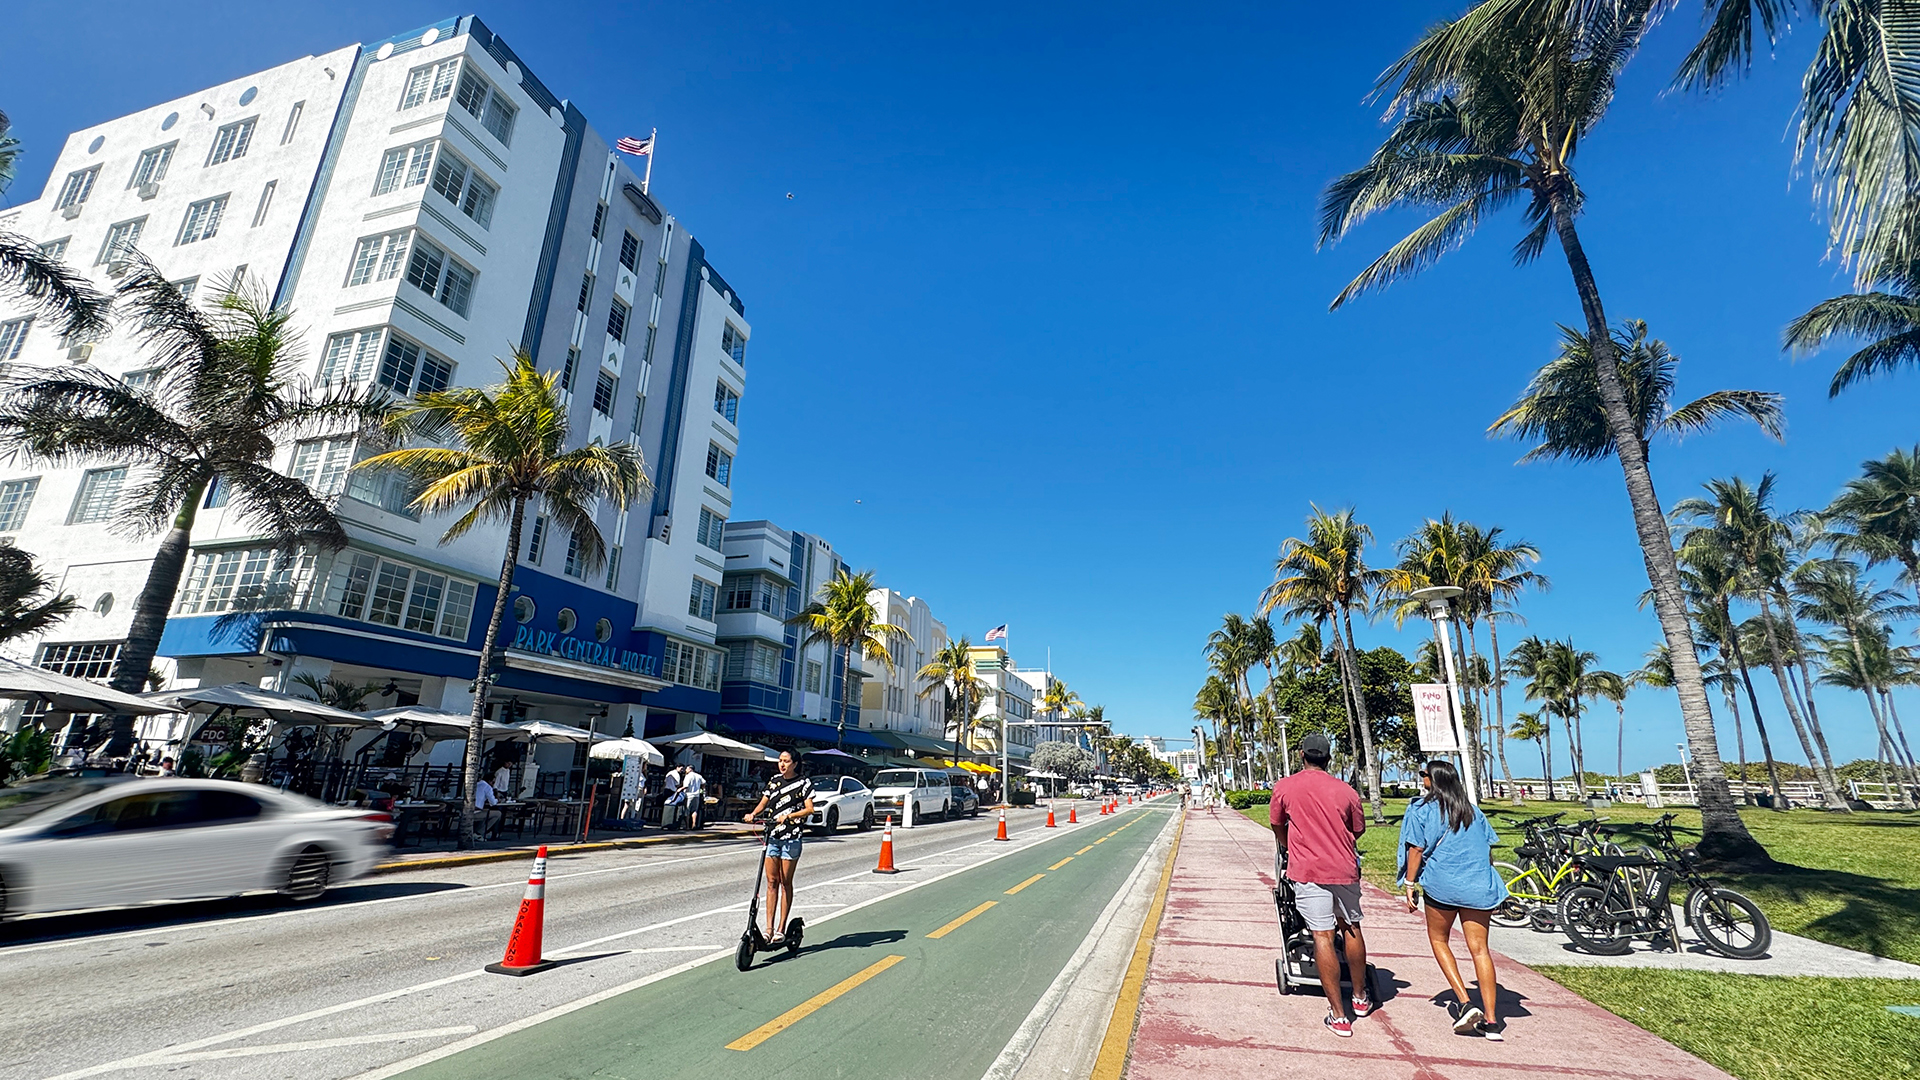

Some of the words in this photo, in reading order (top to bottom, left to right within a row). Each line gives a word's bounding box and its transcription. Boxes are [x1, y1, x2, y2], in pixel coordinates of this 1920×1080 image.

[515, 625, 557, 655] PARK
[560, 636, 617, 668] CENTRAL
[620, 650, 657, 676] HOTEL
[1422, 692, 1441, 700] FIND
[201, 730, 225, 740] FDC
[520, 900, 530, 913] NO
[506, 915, 525, 962] PARKING
